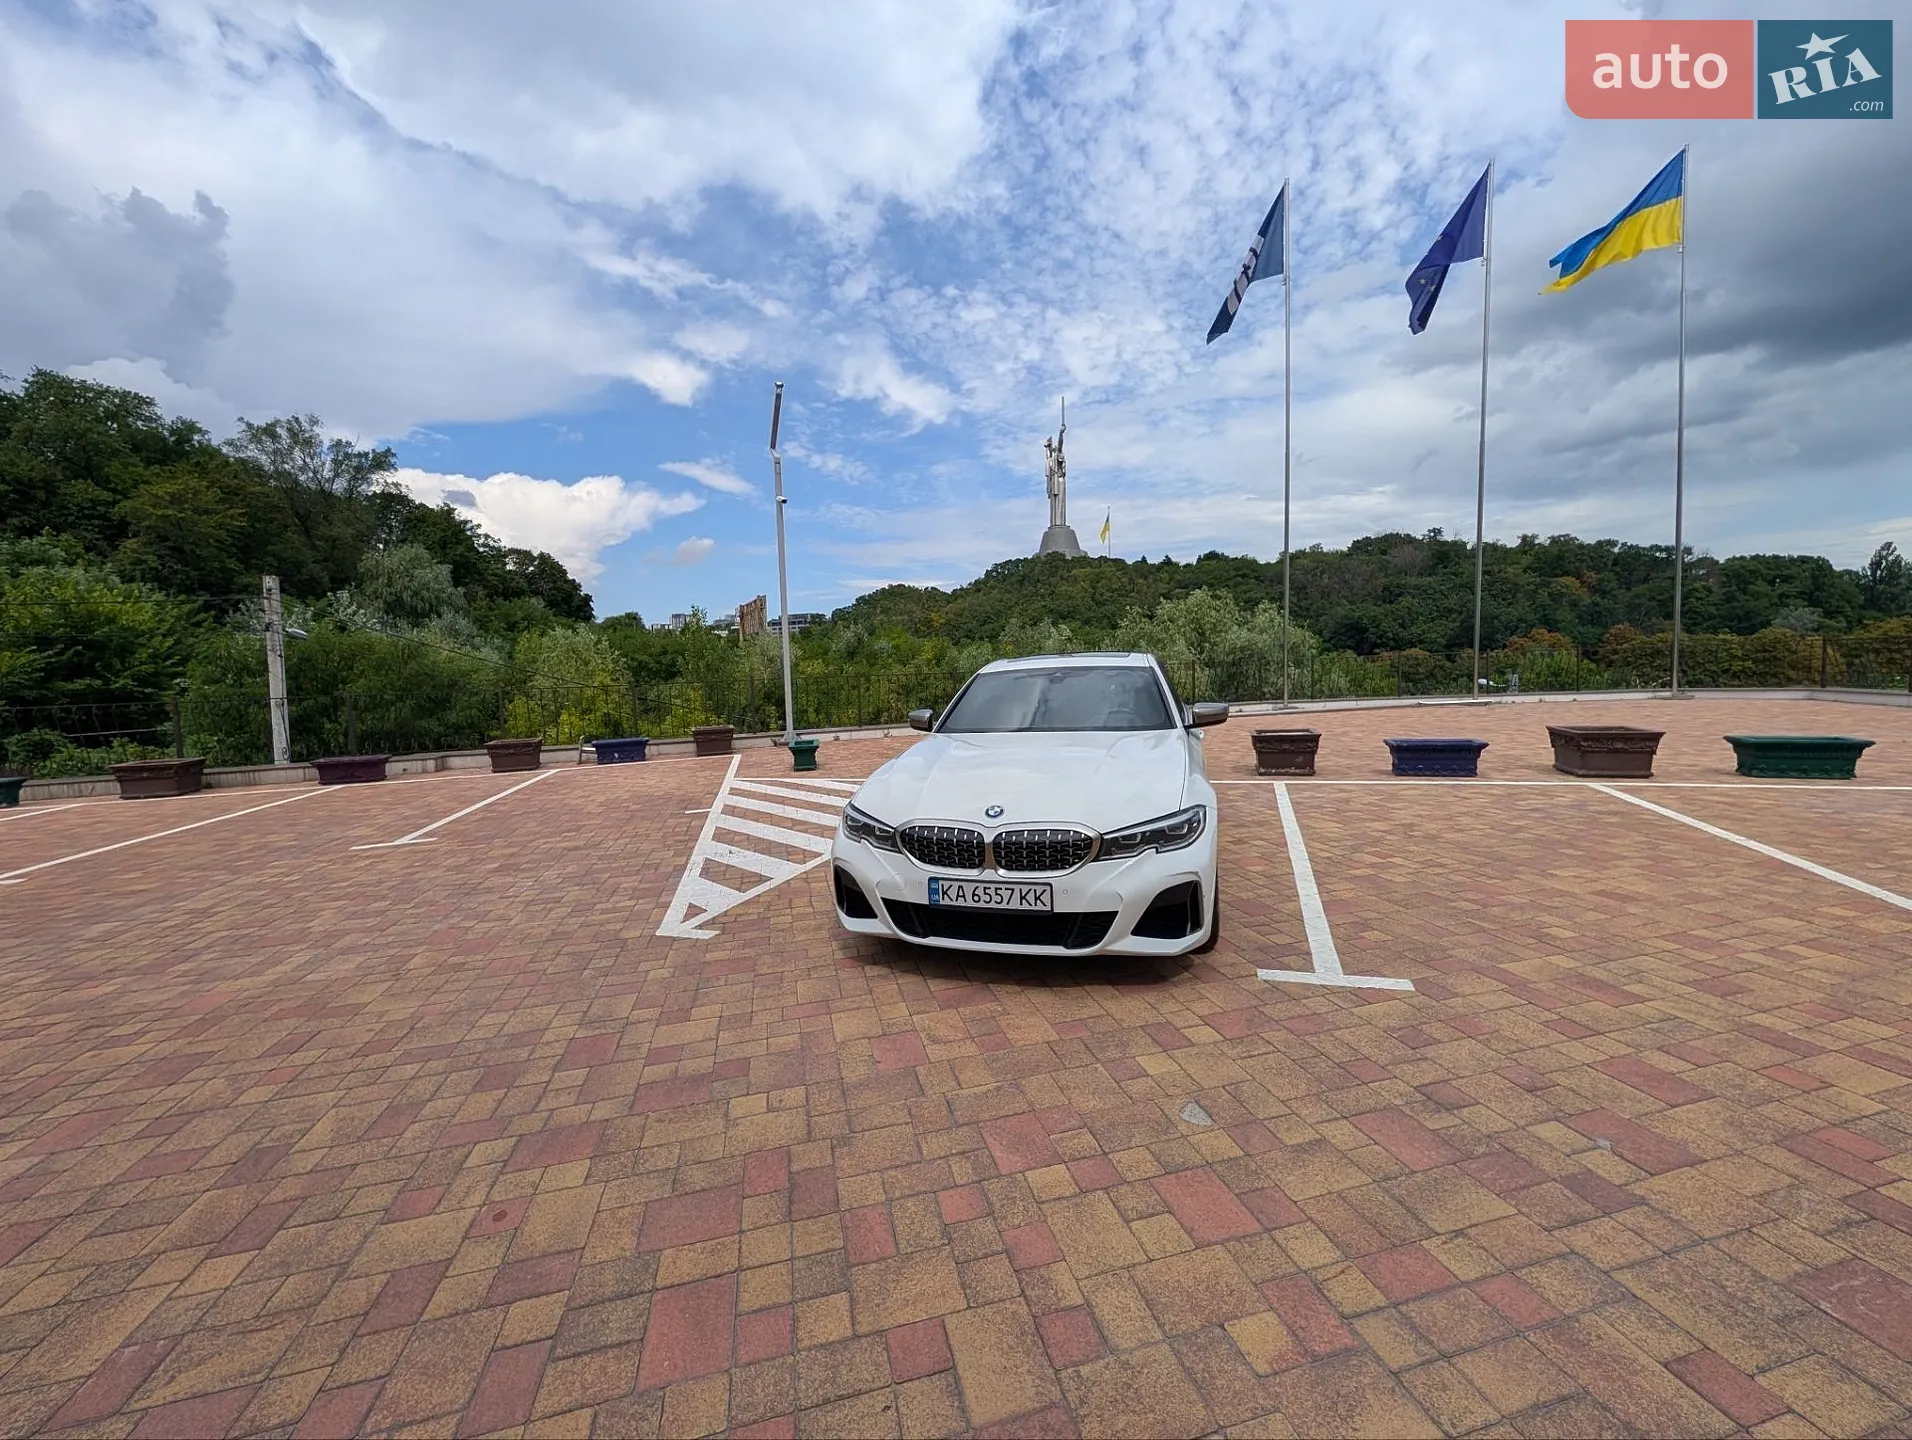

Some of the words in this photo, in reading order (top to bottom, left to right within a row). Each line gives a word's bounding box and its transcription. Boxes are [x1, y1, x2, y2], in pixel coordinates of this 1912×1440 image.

[941, 883, 967, 903] KA
[971, 886, 1016, 906] 6557
[1019, 887, 1048, 907] KK
